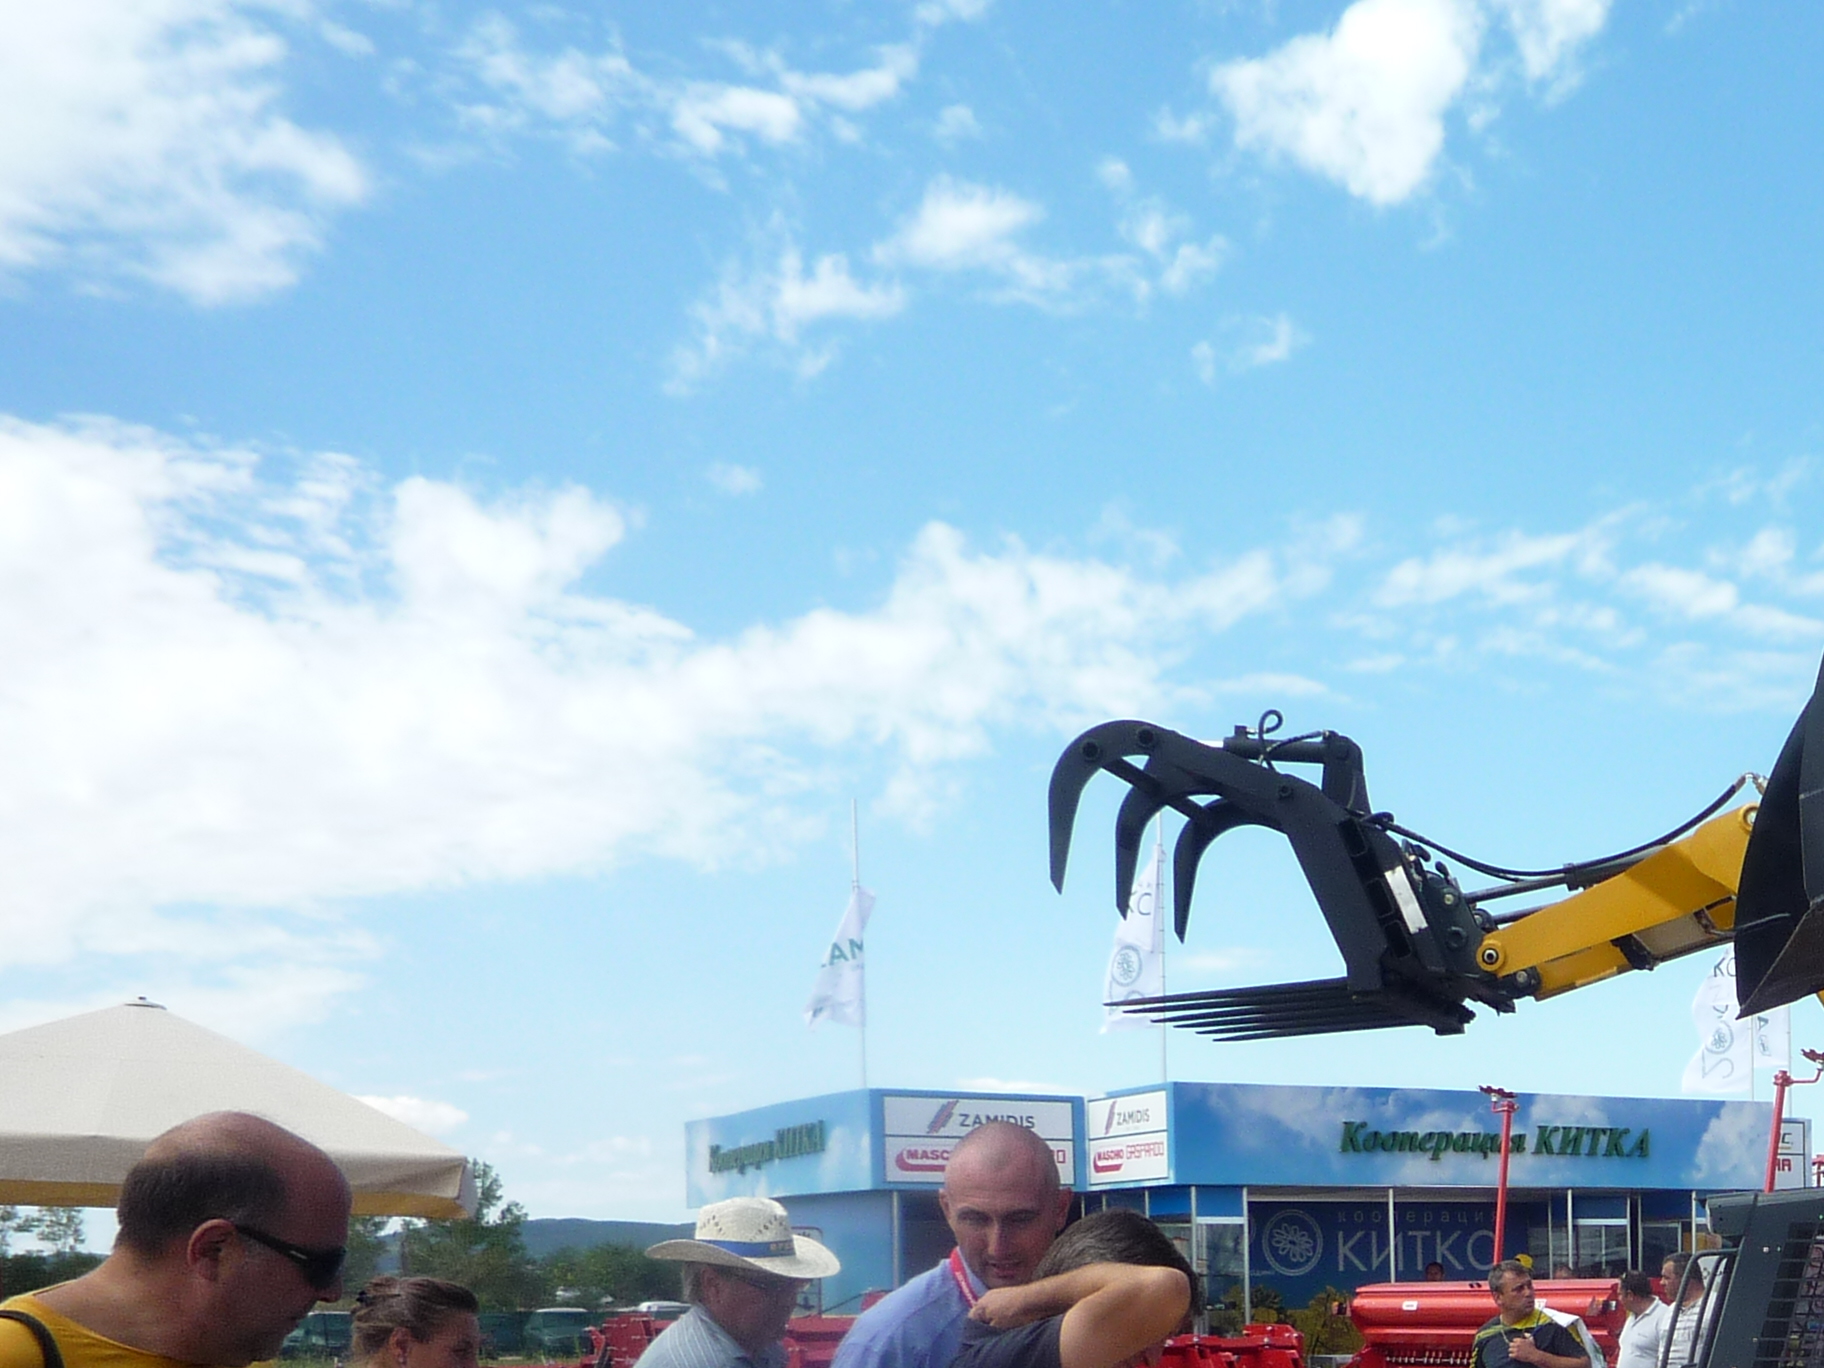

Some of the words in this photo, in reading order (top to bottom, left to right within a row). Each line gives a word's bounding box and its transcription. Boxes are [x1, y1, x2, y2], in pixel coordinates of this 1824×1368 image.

[1116, 1108, 1150, 1126] ZAMIDIS
[1339, 1121, 1527, 1161] Коопераця
[1531, 1124, 1650, 1158] КИТКА
[905, 1149, 951, 1161] MASC
[1338, 1210, 1496, 1226] кооераци
